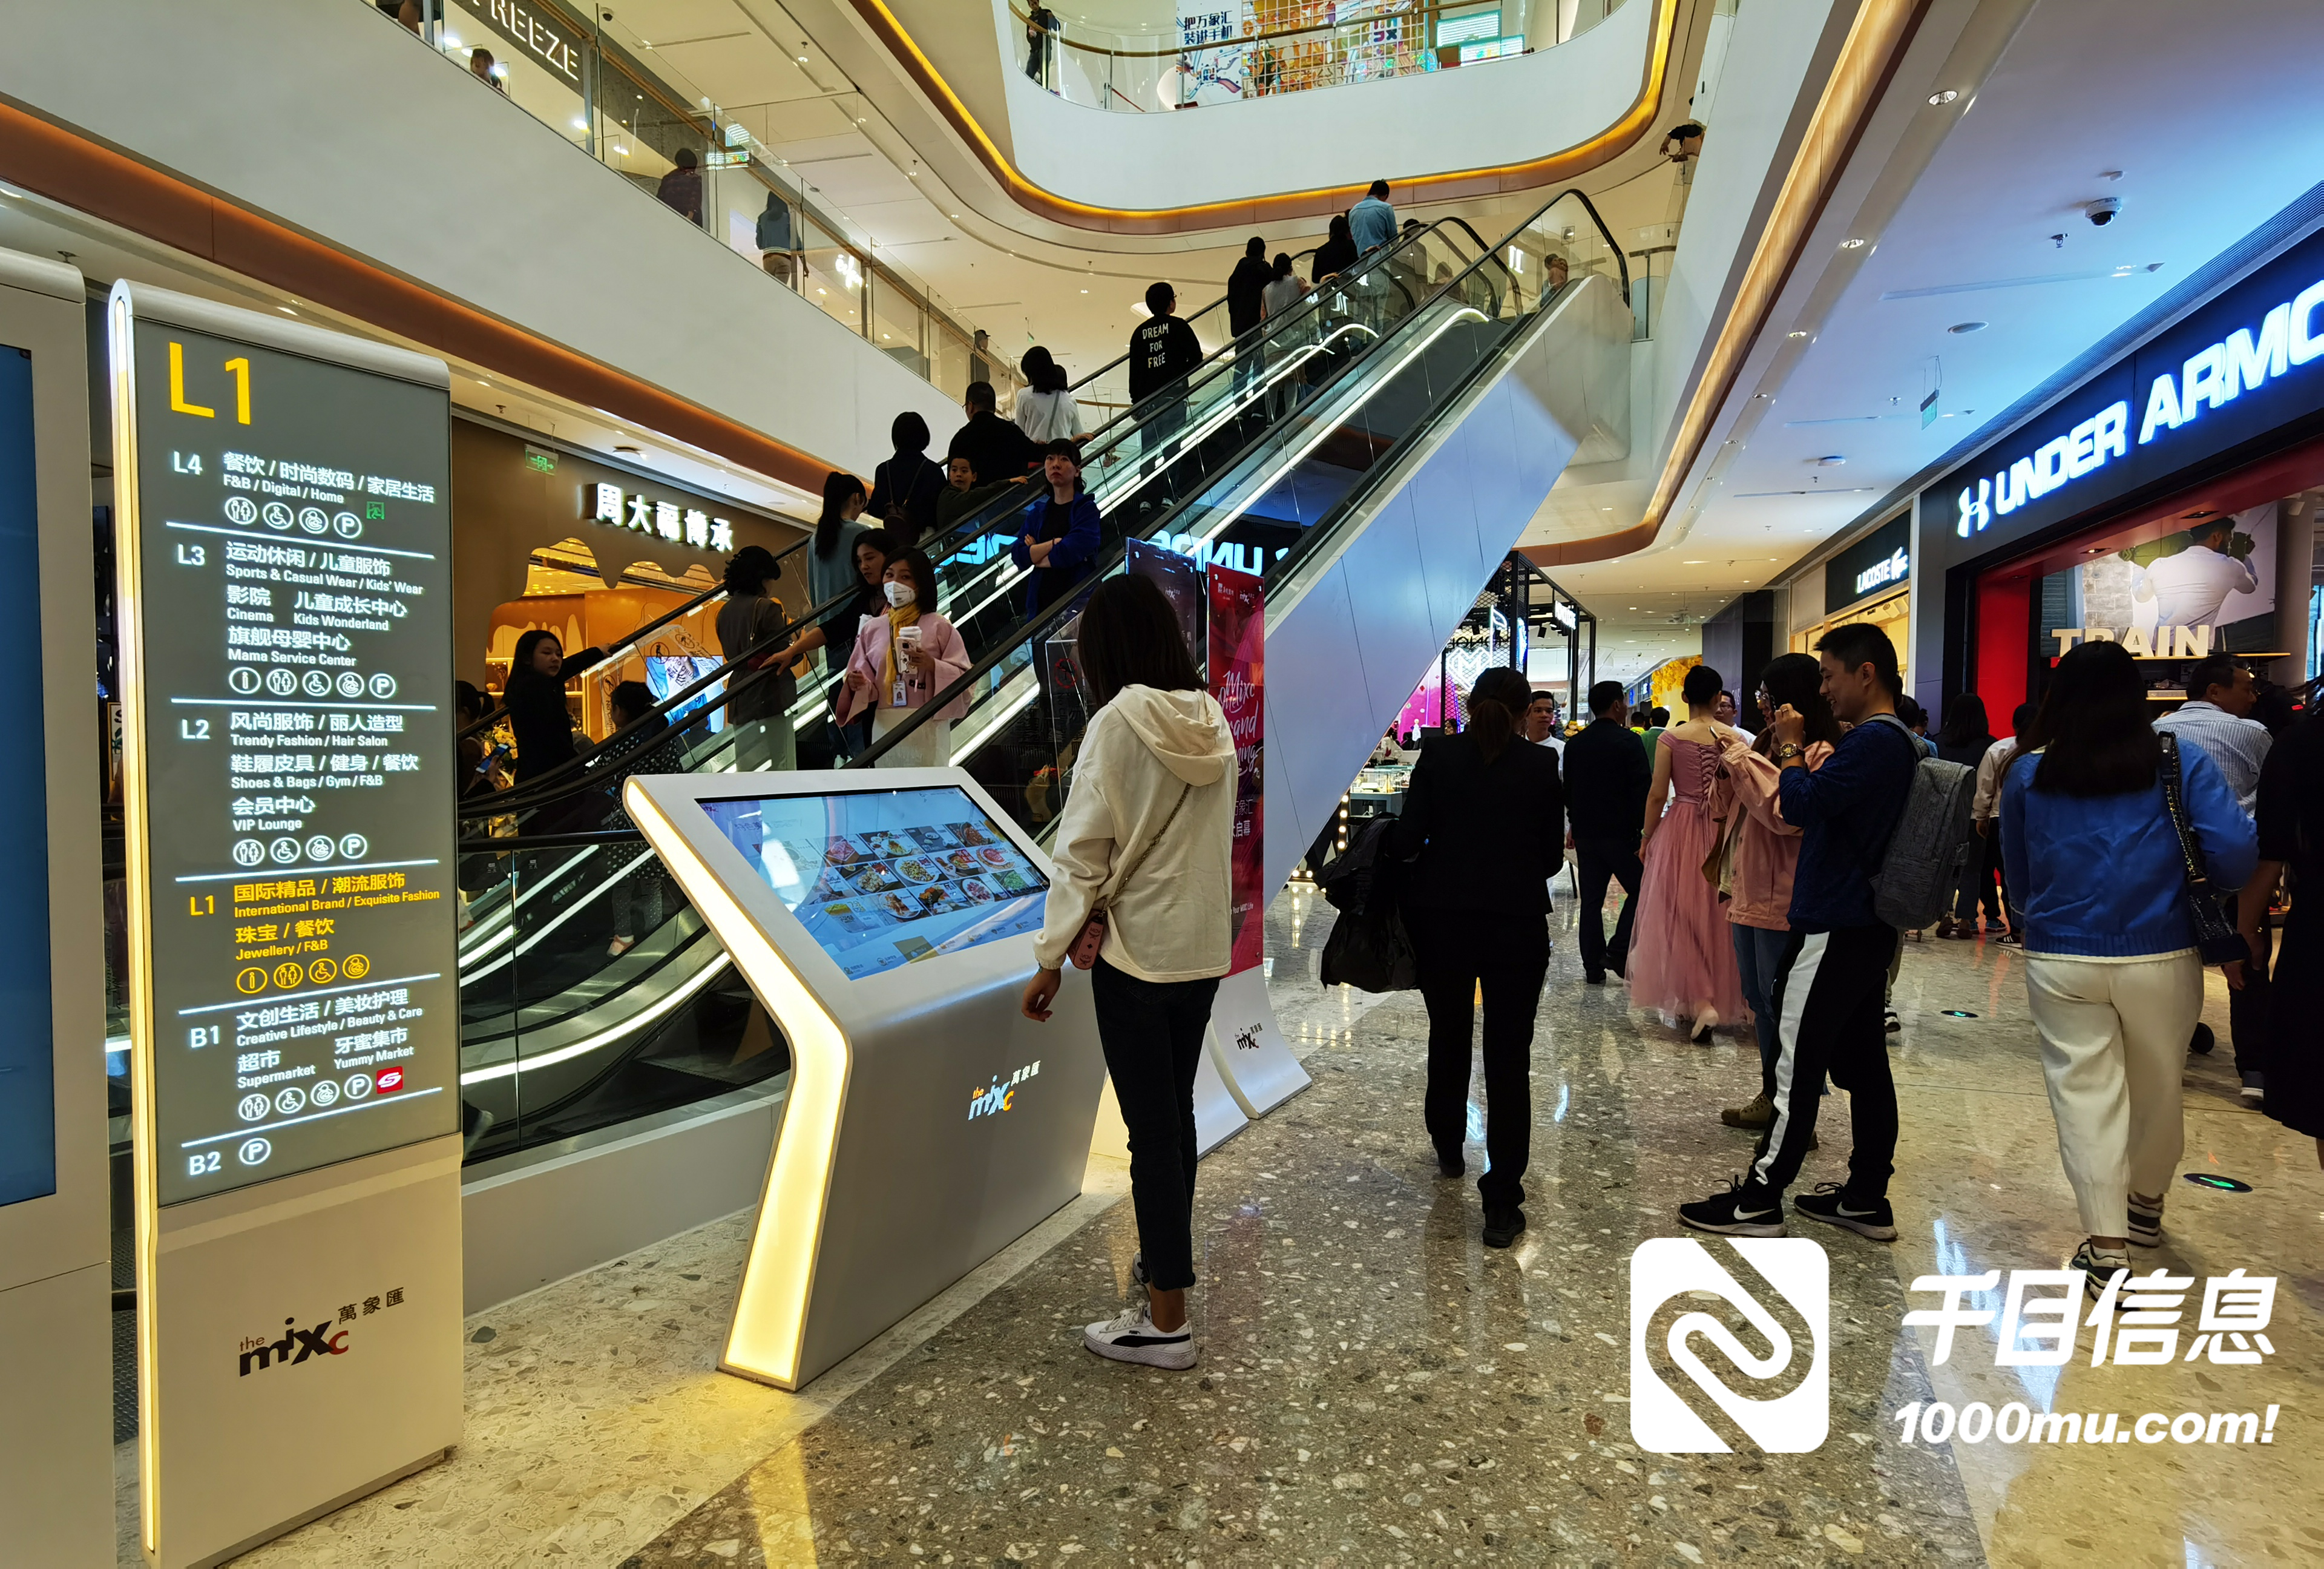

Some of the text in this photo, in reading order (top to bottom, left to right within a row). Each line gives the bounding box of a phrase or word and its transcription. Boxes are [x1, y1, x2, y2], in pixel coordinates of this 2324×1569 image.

[1184, 25, 1233, 45] 装进手机
[1142, 323, 1169, 340] DREAM
[1149, 340, 1163, 352] FOR
[1148, 352, 1166, 368] FREE
[169, 341, 251, 425] L1
[174, 451, 203, 475] L4
[1995, 400, 2129, 516] UNDER
[223, 452, 265, 476] 餐饮
[280, 462, 355, 490] 时尚数码
[367, 476, 435, 503] 家居生活
[223, 475, 251, 488] F&B
[262, 481, 301, 498] Digital
[311, 488, 344, 503] Home
[178, 544, 205, 567] L3
[226, 542, 305, 567] 运动休闲
[320, 553, 390, 577] 儿童服饰
[226, 564, 268, 581] Sports
[271, 568, 281, 581] &
[284, 570, 323, 585] Casual
[326, 575, 356, 588] Wear
[395, 581, 423, 595] Wear
[227, 585, 408, 619] 影院 儿童成长中心
[227, 608, 389, 631] Cinema Kids Wonderland
[228, 626, 352, 651] 旗舰母婴中心
[228, 648, 356, 666] Mama Service Center
[182, 719, 210, 740] L2
[231, 712, 314, 732] 风尚服饰
[329, 714, 404, 732] 丽人造型
[231, 734, 274, 748] Trendy
[277, 734, 323, 746] Fashion
[332, 735, 356, 746] Hair
[358, 735, 388, 747] Salon
[231, 754, 315, 774] 鞋履皮具
[330, 754, 368, 772] 健身
[382, 754, 419, 771] 餐饮
[231, 777, 271, 789] Shoes
[273, 777, 284, 788] &
[286, 776, 317, 789] Bags
[326, 775, 351, 788] Gym
[360, 775, 383, 786] F&B
[232, 795, 317, 816] 会员中心
[233, 818, 303, 832] VIP Lounge
[234, 879, 316, 903] 国际精品
[332, 872, 405, 893] 潮流服饰
[189, 895, 215, 916] L1
[234, 900, 309, 918] International
[312, 898, 345, 910] Brand
[354, 892, 401, 907] Exquisite
[402, 889, 440, 902] Fashion
[235, 923, 278, 944] 珠宝
[295, 917, 335, 938] 餐饮
[235, 942, 295, 961] Jewellery
[304, 939, 328, 952] F&B
[237, 1002, 319, 1031] 文创生活
[335, 988, 409, 1016] 美妆护理
[190, 1025, 220, 1048] B1
[237, 1030, 287, 1046] Creative
[290, 1020, 338, 1038] Lifestyle
[347, 1013, 386, 1029] Beauty
[387, 1010, 396, 1021] &
[398, 1006, 423, 1020] Care
[238, 1027, 408, 1074] 超市 牙蜜集市
[238, 1047, 414, 1089] Supermarket Yummy Market
[973, 1087, 984, 1099] the
[189, 1151, 221, 1176] B2
[338, 1287, 404, 1325] 萬象匯
[240, 1336, 265, 1352] the
